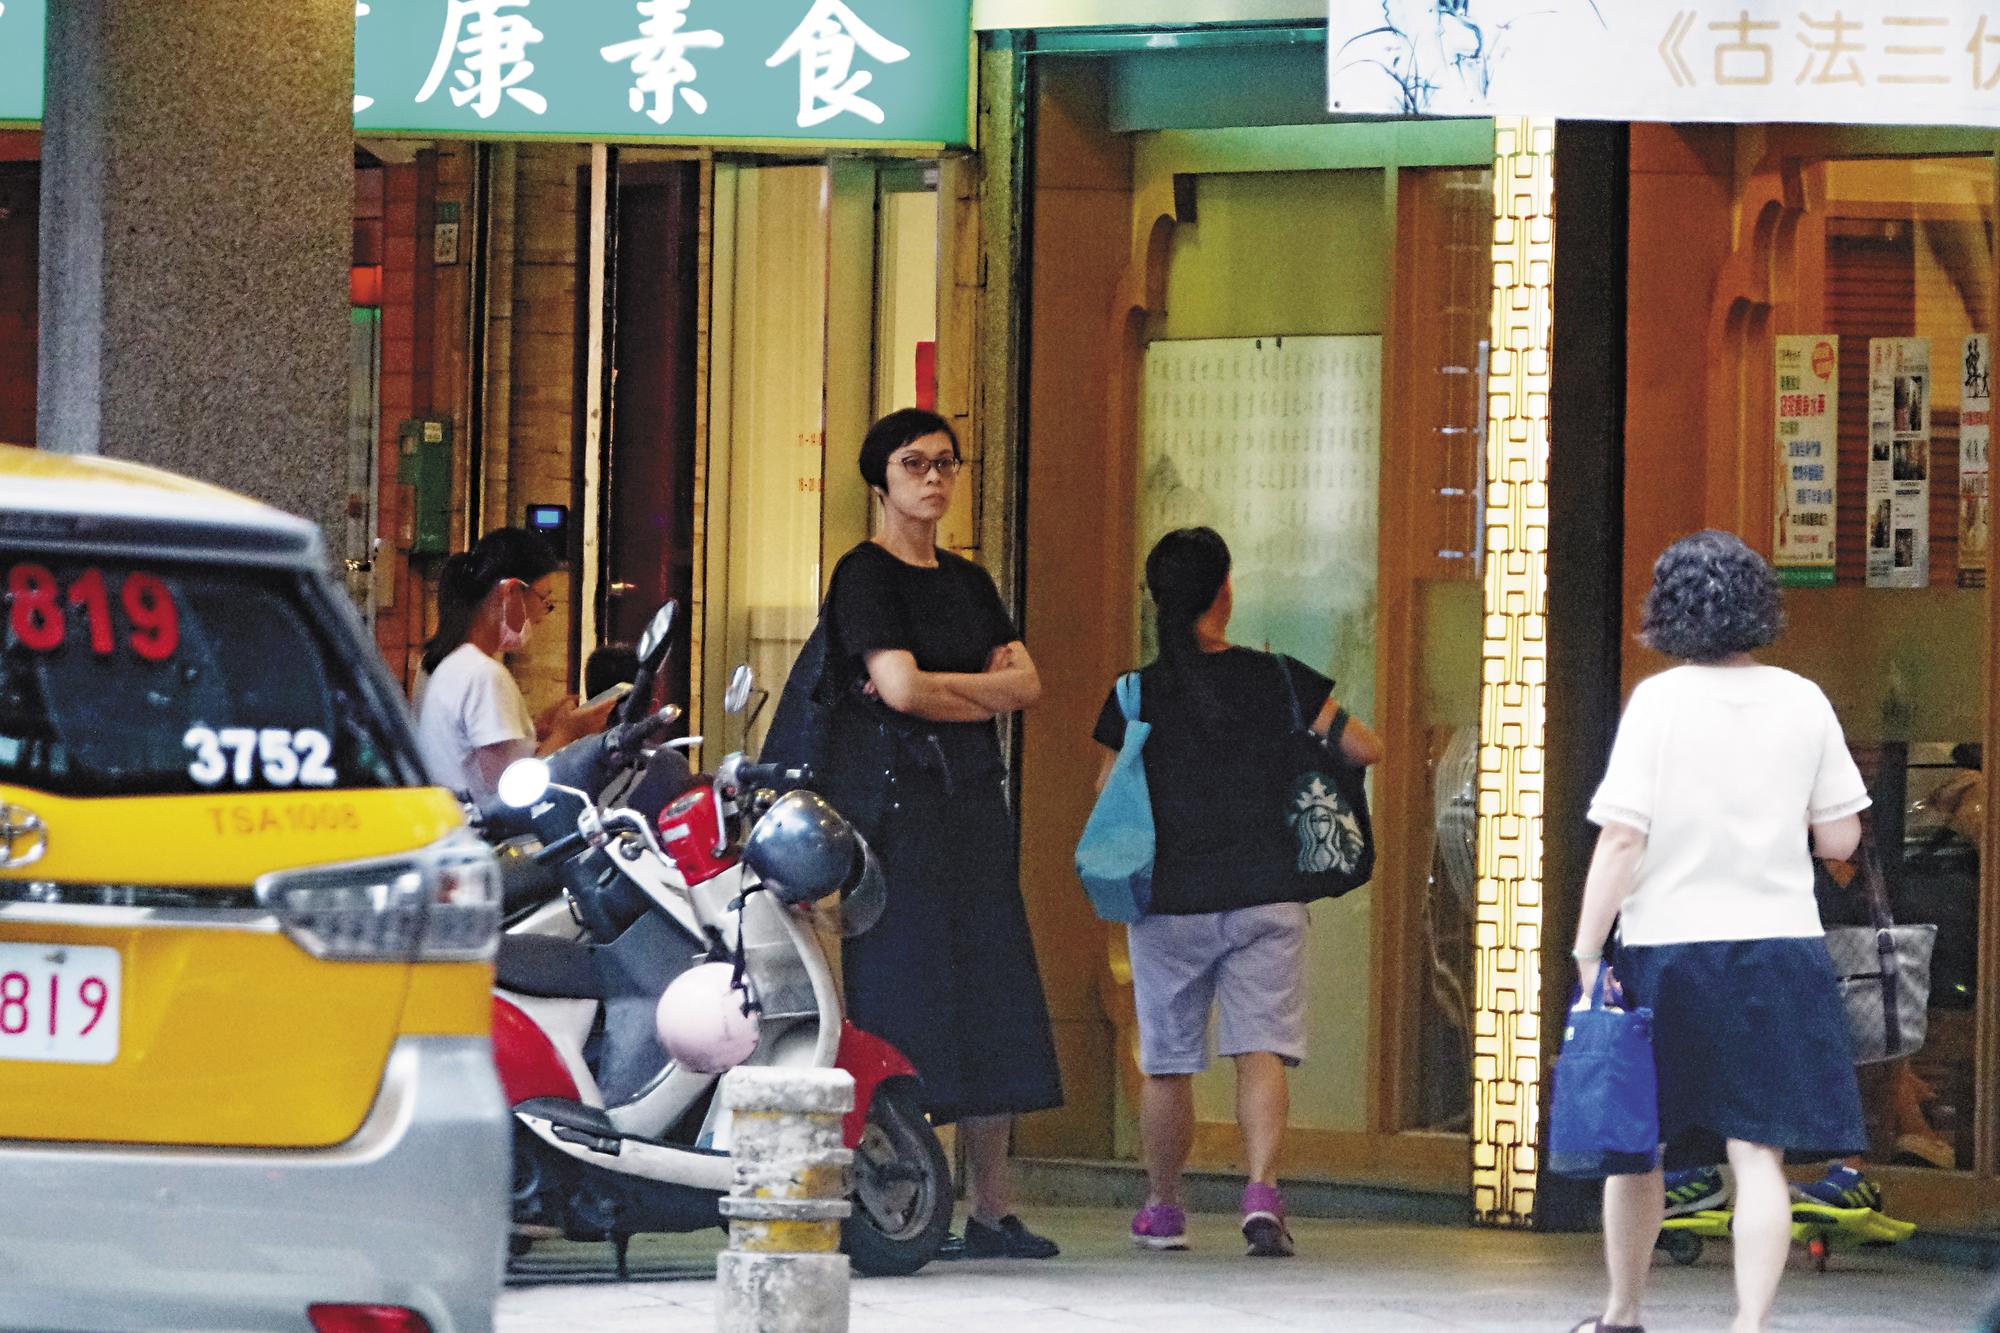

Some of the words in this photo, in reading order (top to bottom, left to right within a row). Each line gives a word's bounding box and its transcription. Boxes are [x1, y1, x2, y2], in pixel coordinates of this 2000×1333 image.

[355, 0, 911, 128] 康素食
[7, 564, 179, 661] 819
[183, 727, 337, 787] 3752
